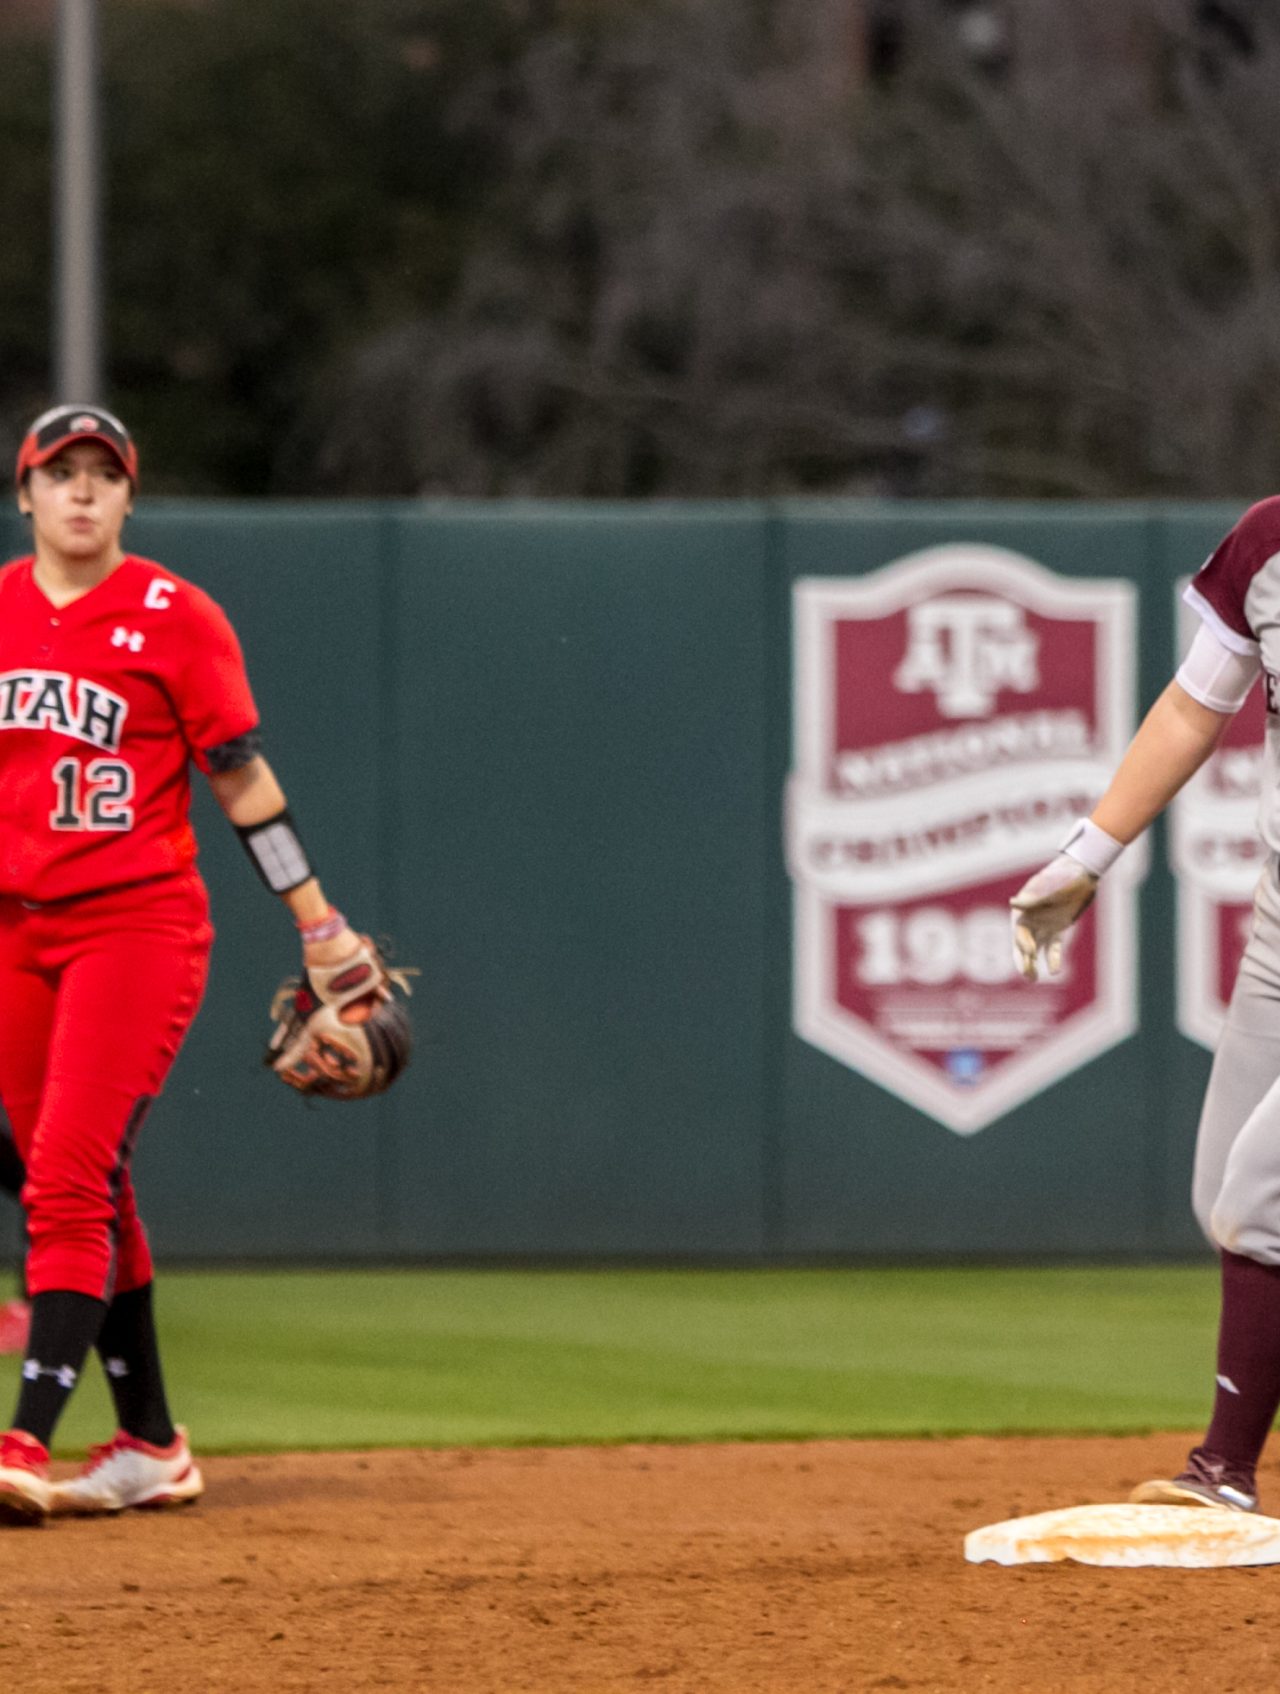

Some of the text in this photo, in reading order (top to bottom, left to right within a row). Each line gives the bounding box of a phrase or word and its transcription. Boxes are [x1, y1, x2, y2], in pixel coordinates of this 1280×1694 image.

[144, 579, 176, 610] C
[0, 668, 128, 755] TAH
[50, 756, 135, 831] 12
[855, 907, 1071, 985] 198
